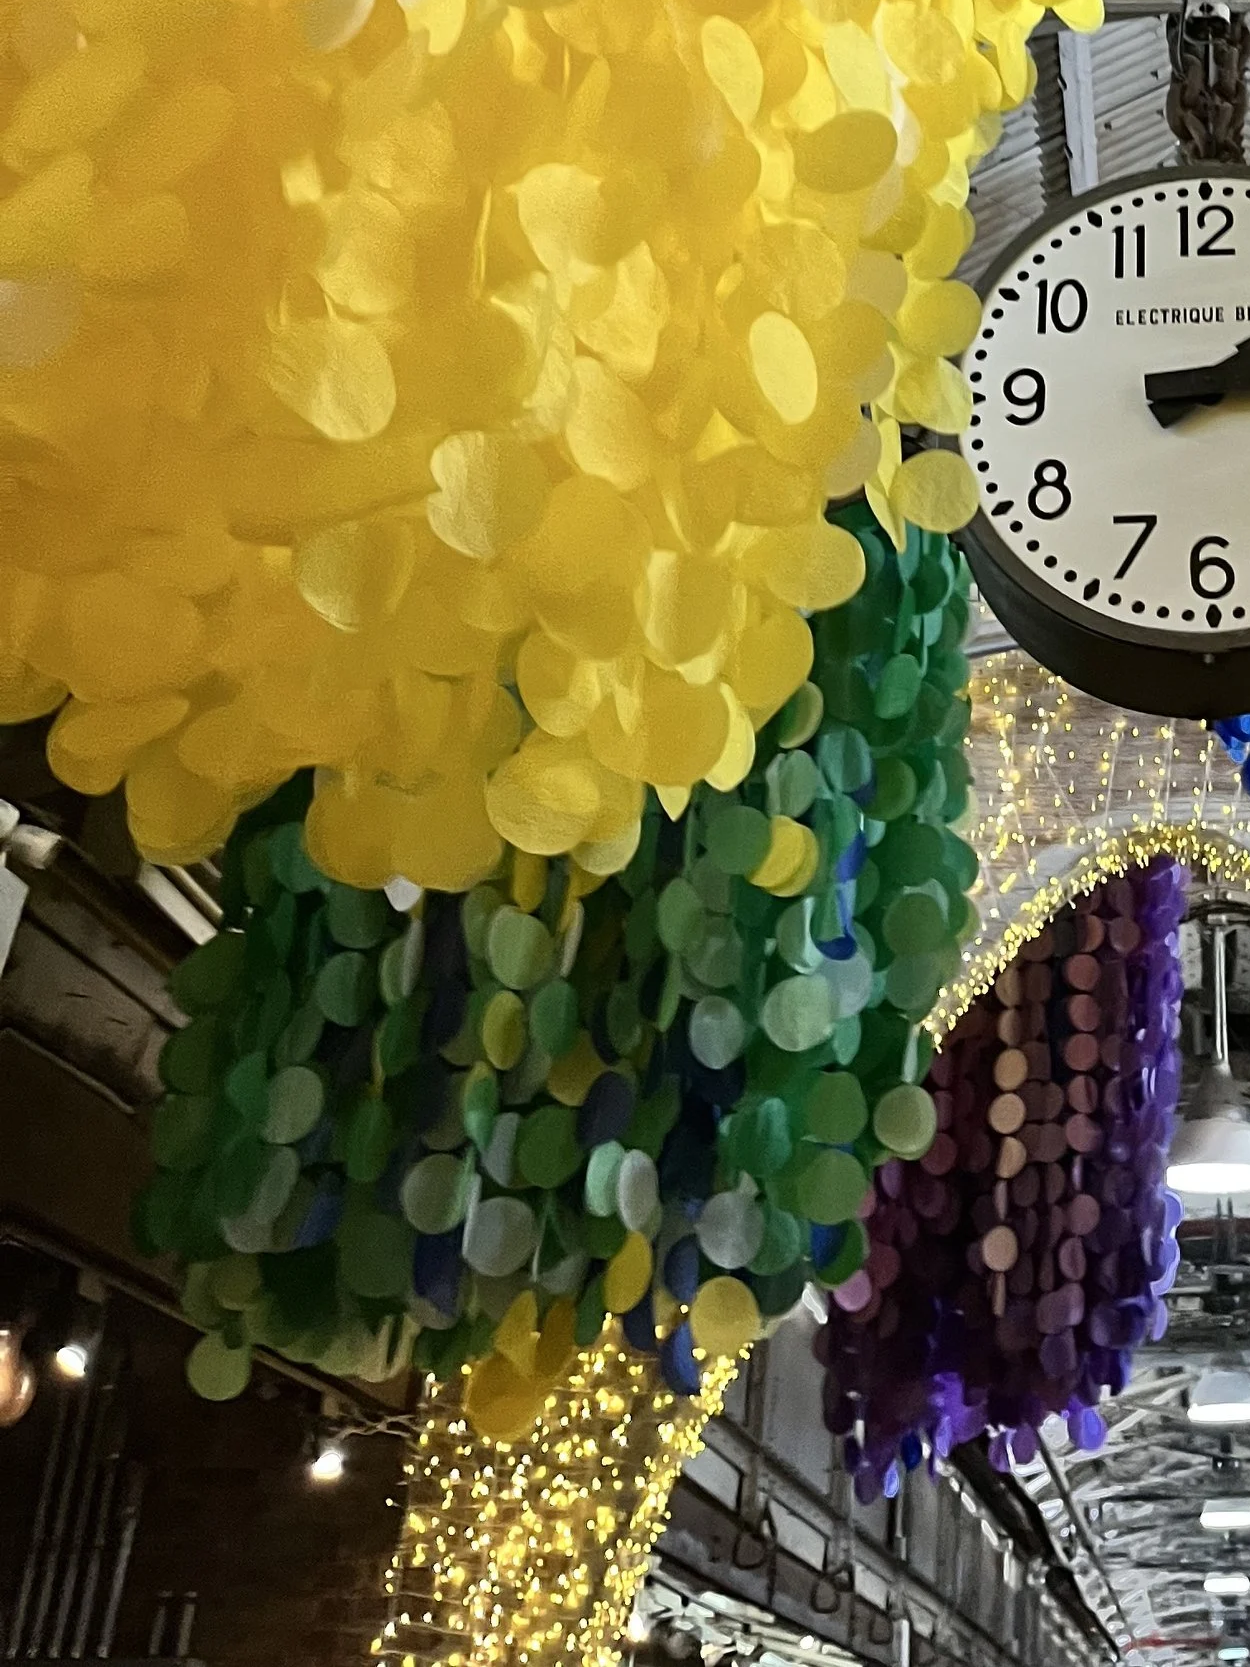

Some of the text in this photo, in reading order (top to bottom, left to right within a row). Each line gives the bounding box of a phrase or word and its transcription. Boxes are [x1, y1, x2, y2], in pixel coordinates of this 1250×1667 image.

[1112, 225, 1146, 278] 11
[1176, 205, 1236, 257] 12
[1036, 279, 1088, 334] 10
[1115, 306, 1225, 326] ELECTRIQUE
[1002, 368, 1046, 426] 9
[1027, 459, 1072, 521] 8
[1112, 515, 1158, 581] 7
[1189, 536, 1236, 600] 6
